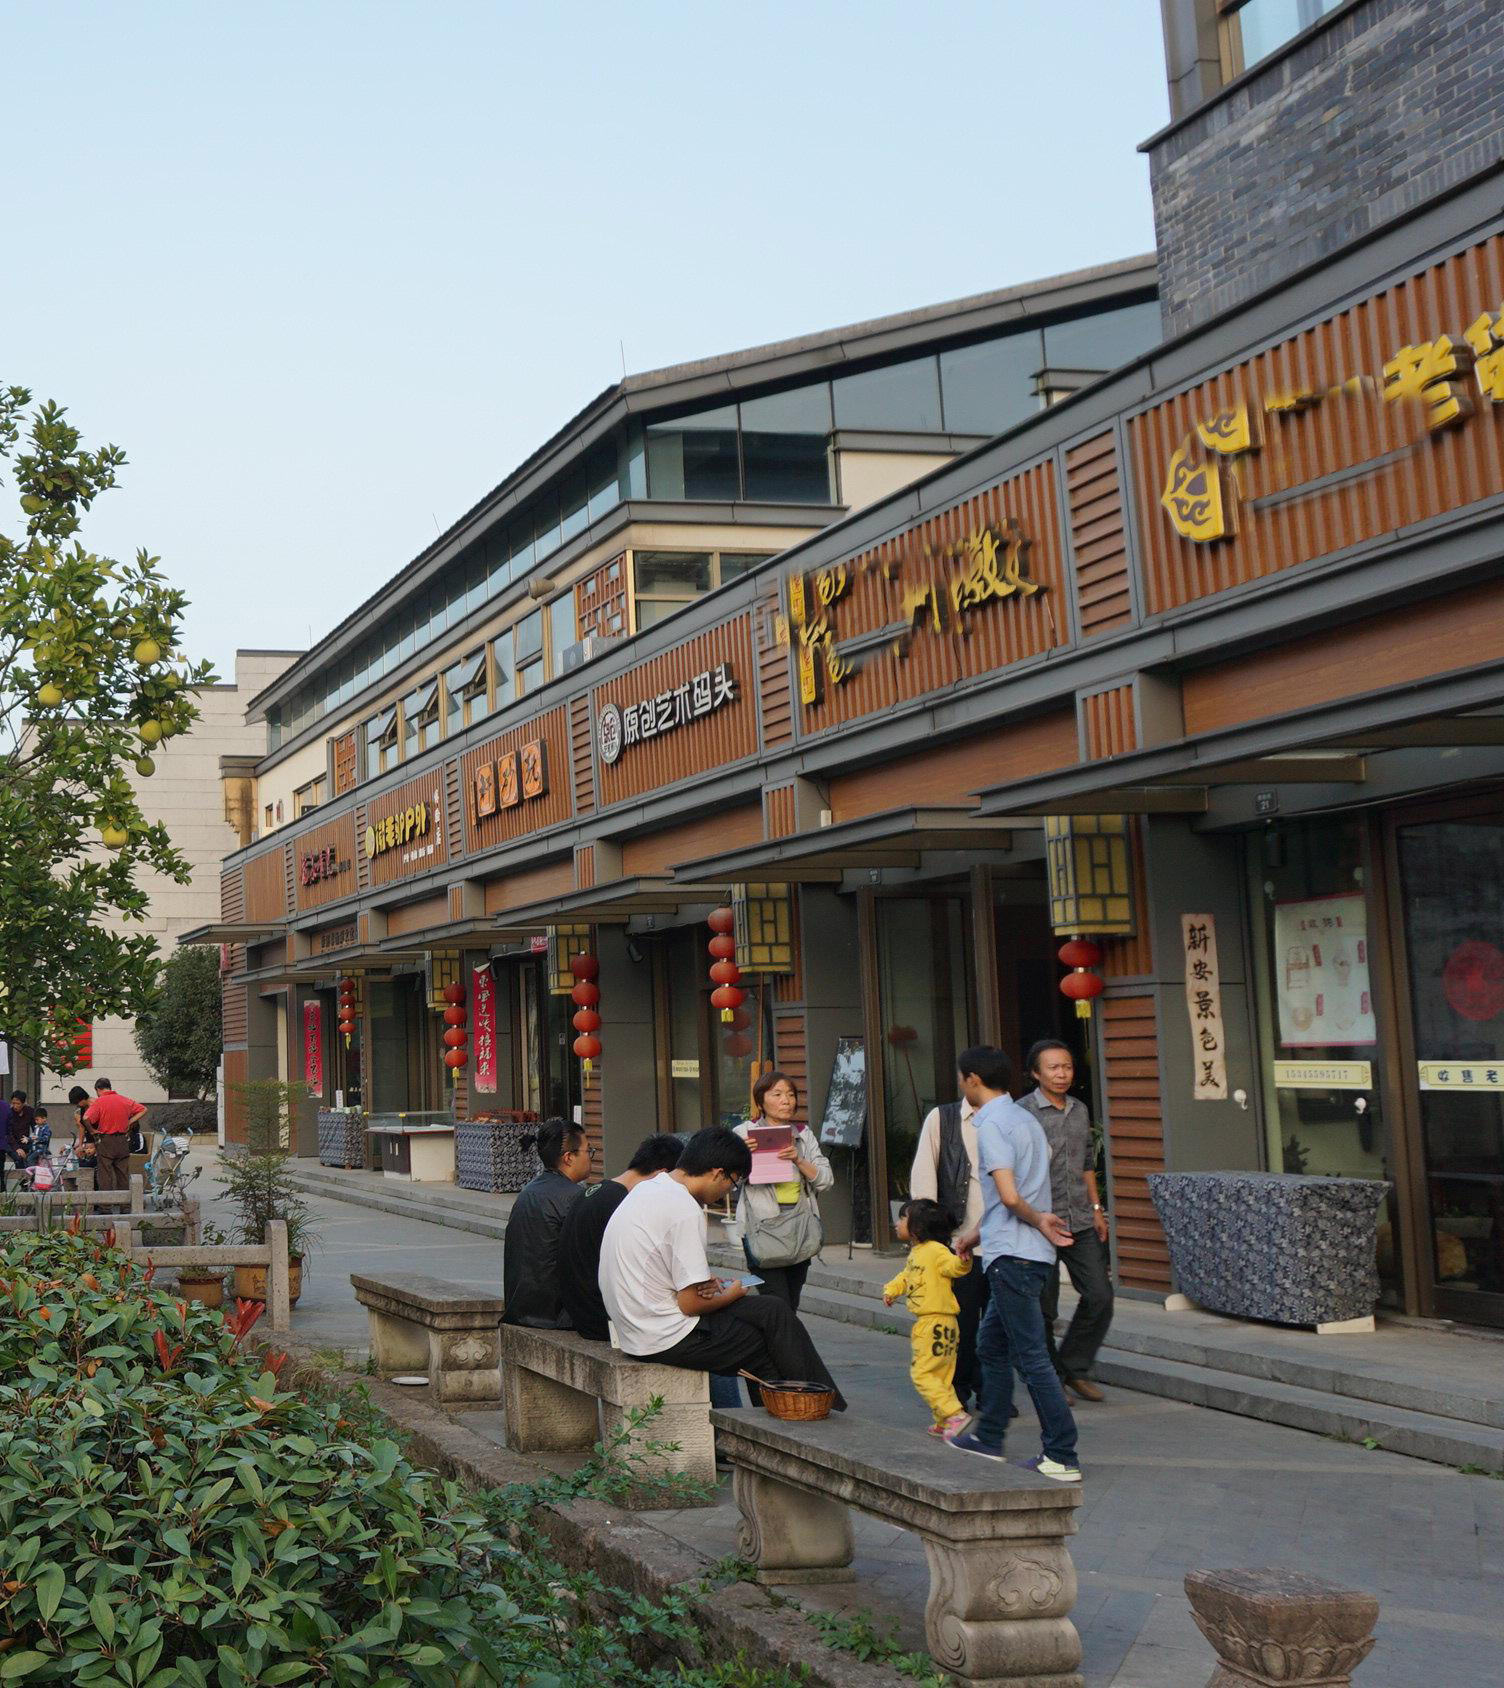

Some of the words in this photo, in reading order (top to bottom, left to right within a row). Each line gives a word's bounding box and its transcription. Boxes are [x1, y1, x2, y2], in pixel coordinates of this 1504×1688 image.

[624, 662, 734, 745] 原创艺术码头
[1188, 923, 1220, 1088] 新安景色美
